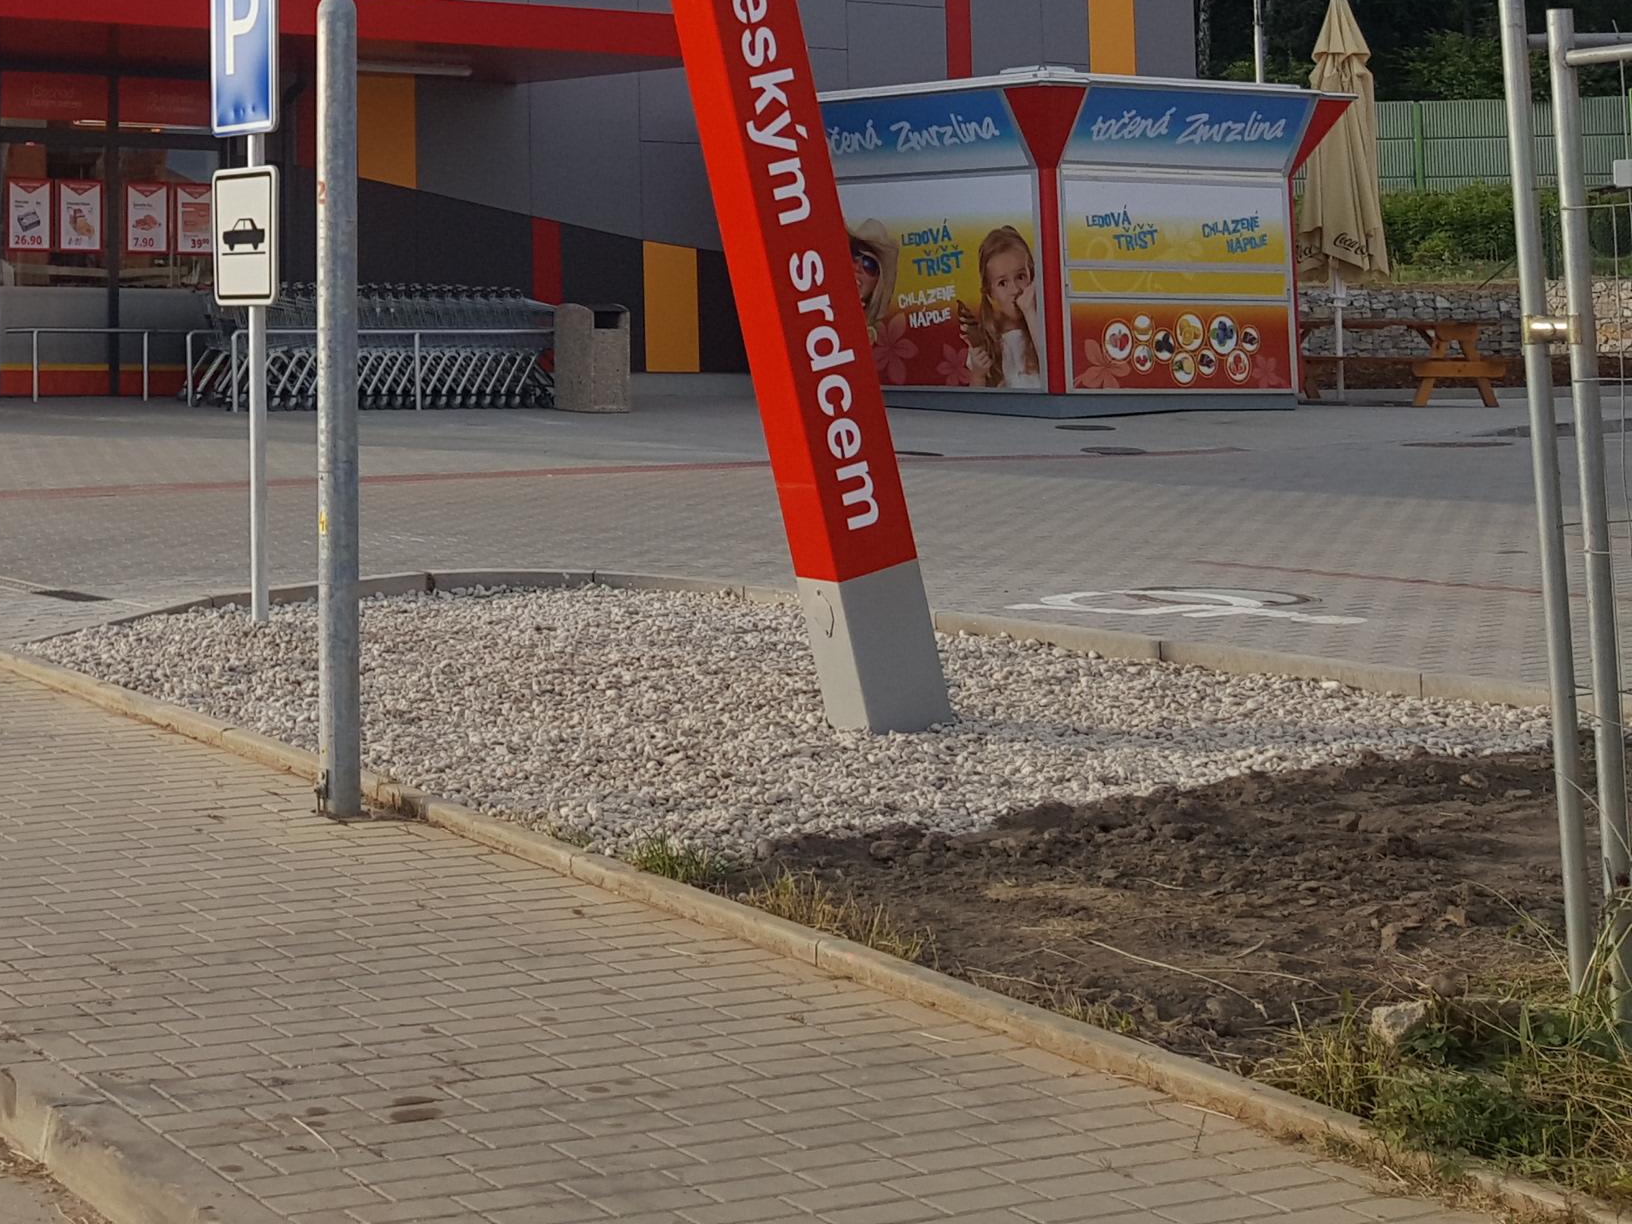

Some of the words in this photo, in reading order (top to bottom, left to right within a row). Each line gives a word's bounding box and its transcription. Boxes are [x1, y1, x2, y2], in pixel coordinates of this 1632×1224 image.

[826, 118, 883, 156] čená
[889, 112, 1001, 153] Zmrzlina
[1090, 106, 1177, 143] točená
[1175, 109, 1287, 145] Zmrzlina
[1085, 204, 1132, 229] LEDOVÁ
[1201, 210, 1260, 239] CHLAZENÉ
[14, 235, 43, 245] 26.90
[133, 237, 155, 248] 7.90
[901, 218, 953, 247] LEDOVÁ
[1226, 232, 1269, 255] NÁPOJE
[909, 306, 951, 328] NÁPOJE
[788, 249, 880, 531] srdcem
